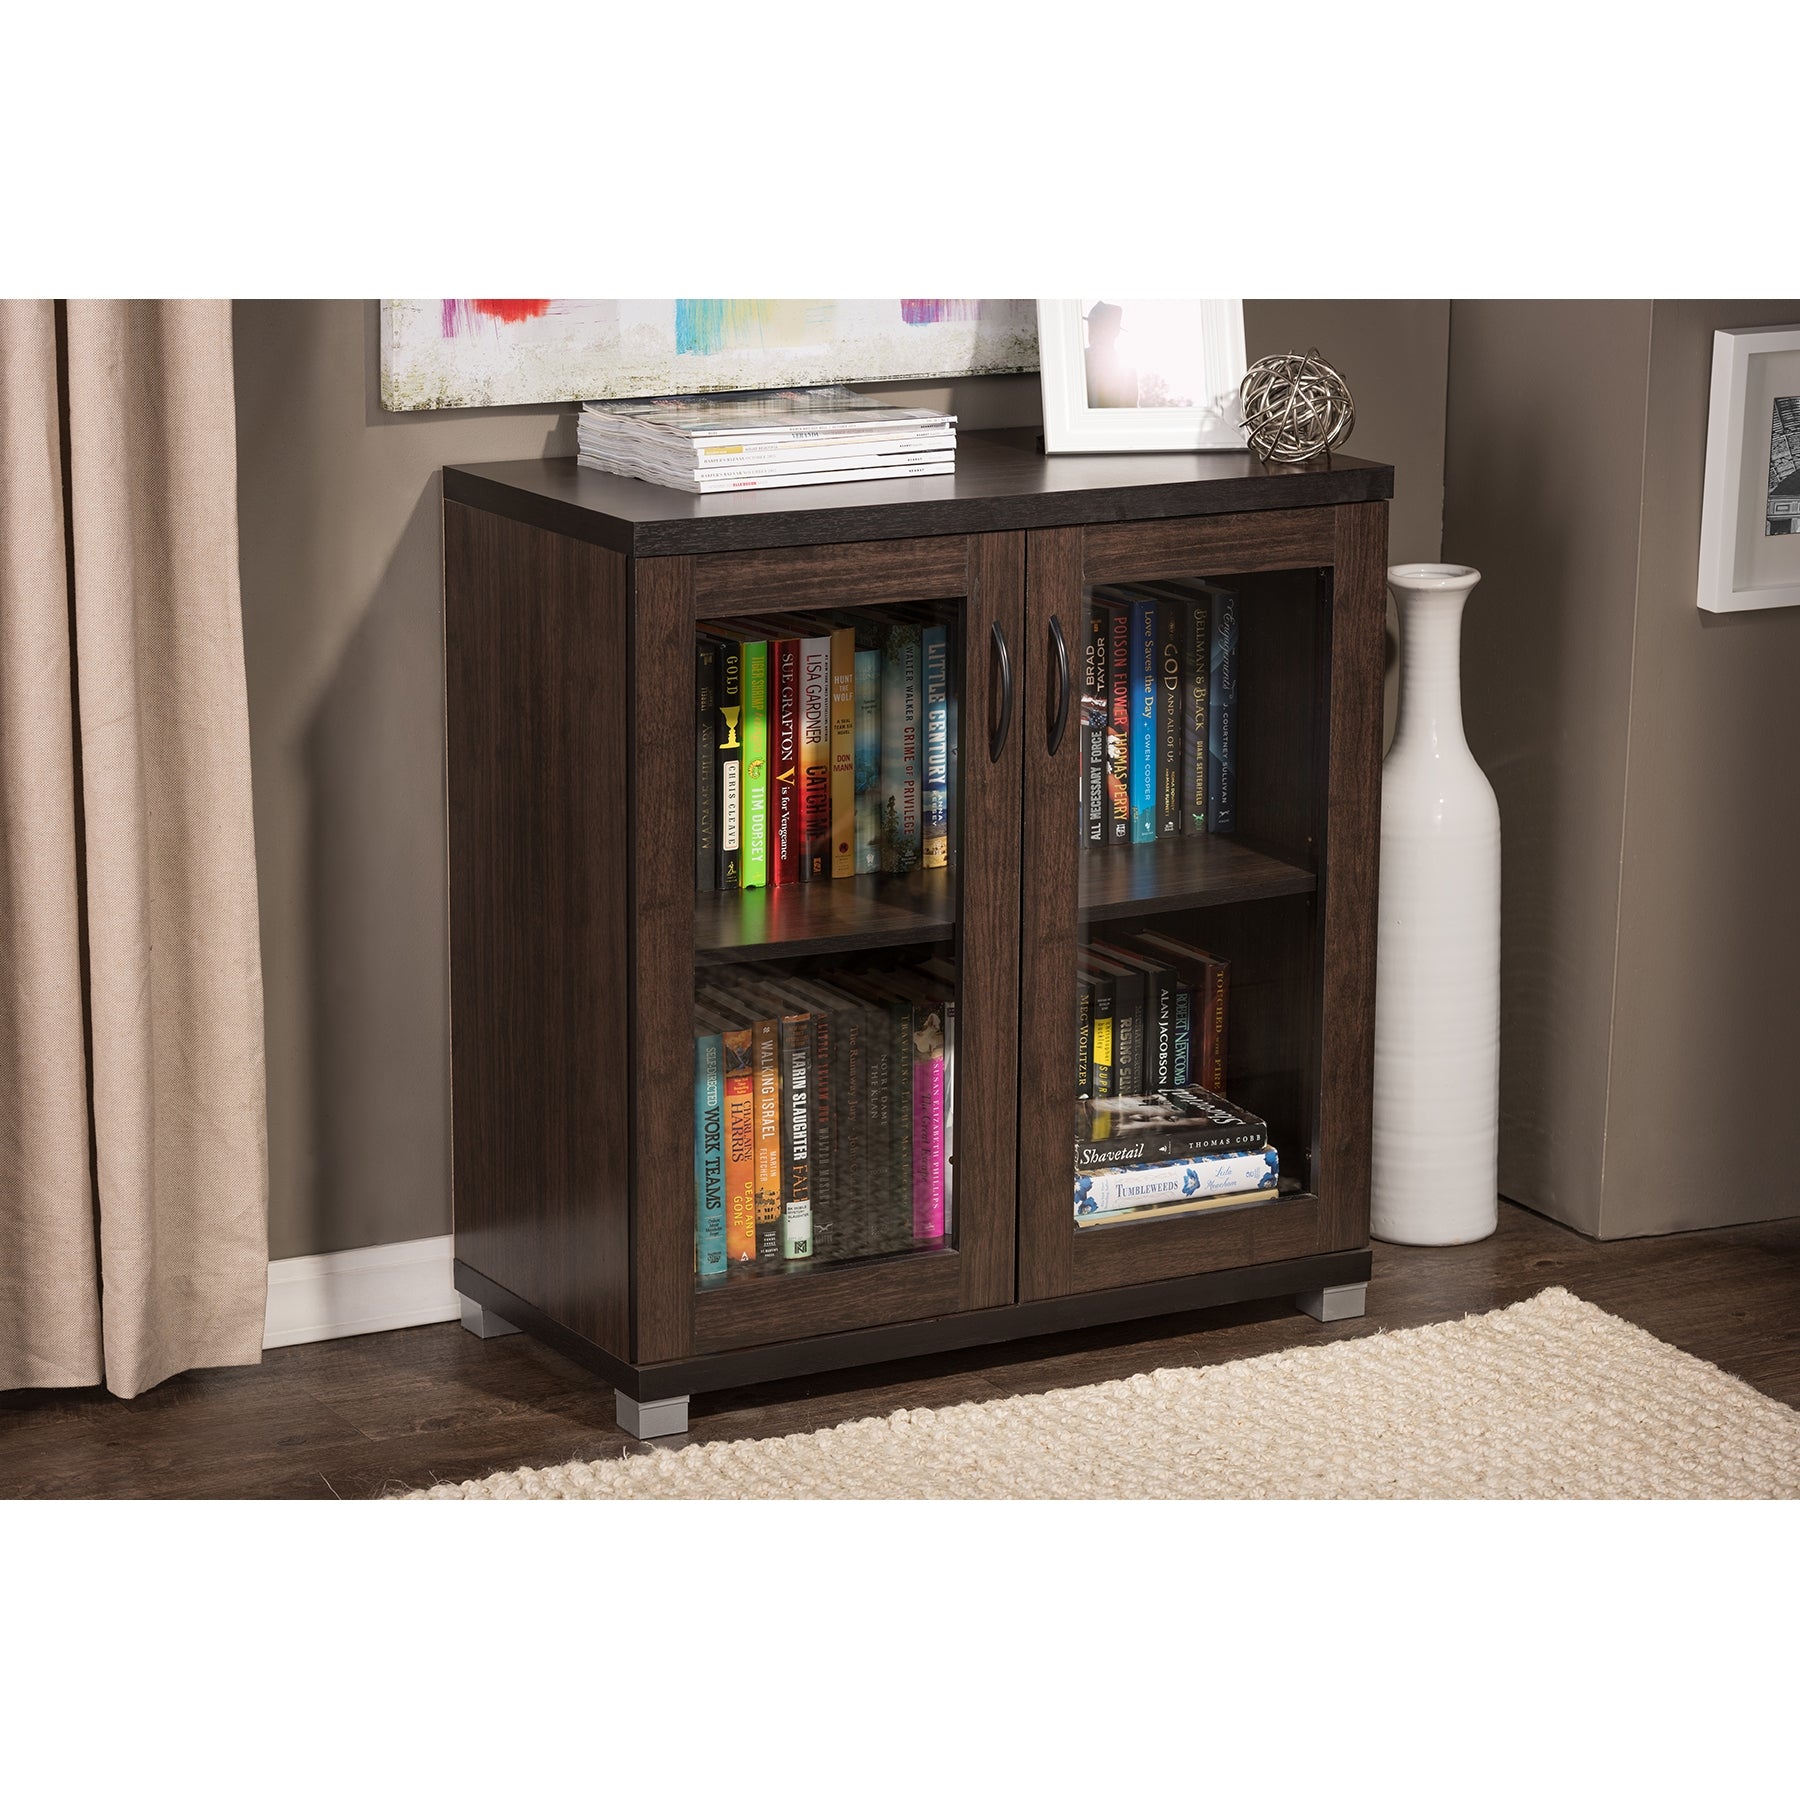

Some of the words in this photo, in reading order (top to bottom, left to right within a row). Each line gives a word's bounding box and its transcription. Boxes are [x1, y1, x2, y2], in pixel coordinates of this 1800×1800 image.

[1144, 610, 1155, 638] Love
[1193, 608, 1208, 674] BELLMAN
[1112, 616, 1129, 669] POISON
[1144, 640, 1154, 673] Saves
[726, 655, 739, 695] GOLD
[751, 656, 765, 679] TIGER
[781, 653, 794, 684] SUE
[805, 653, 823, 682] LISA
[833, 674, 853, 686] HUNT
[905, 646, 914, 682] WALTER
[928, 642, 946, 704] LITTLE
[1086, 645, 1096, 687] BRAD
[1097, 636, 1106, 693] TAYLOR
[1163, 643, 1179, 691] GOD
[1195, 676, 1204, 685] &
[751, 679, 765, 711] SHRIMP
[832, 691, 854, 703] WOLF
[839, 684, 849, 692] THE
[1112, 672, 1129, 726] FLOWER
[1144, 674, 1155, 694] the
[805, 684, 822, 745] GARDNER
[905, 684, 914, 722] WALKER
[1142, 696, 1154, 720] Day
[1167, 693, 1175, 715] AND
[1193, 687, 1207, 732] BLACK
[1223, 702, 1230, 710] J.
[781, 686, 794, 762] GRAFTON
[1167, 717, 1175, 735] ALL
[1222, 713, 1230, 759] COURTNEY
[836, 754, 851, 763] DON
[904, 726, 916, 762] CRIME
[928, 709, 947, 784] CENTURY
[1090, 730, 1103, 764] FORCE
[1113, 731, 1129, 781] THOMAS
[1144, 733, 1152, 762] GWEN
[1166, 736, 1174, 749] OF
[1166, 750, 1175, 764] US
[1196, 740, 1204, 761] DIANE
[728, 765, 738, 800] CHRIS
[775, 766, 796, 786] V
[832, 763, 854, 772] MANN
[905, 766, 914, 776] OF
[1144, 763, 1152, 802] COOPER
[1196, 762, 1204, 806] SETTERFIELD
[1221, 761, 1229, 804] SULLIVAN
[751, 787, 765, 811] TIM
[781, 787, 790, 796] is
[781, 797, 791, 811] for
[805, 765, 829, 815] CATCH
[904, 780, 916, 835] PRIVILEGE
[1089, 767, 1102, 822] NECESSARY
[1113, 784, 1128, 821] PERRY
[728, 803, 738, 846] CLEAVE
[751, 815, 766, 862] DORSEY
[778, 811, 790, 861] Vengeance
[806, 818, 829, 842] ME
[1090, 823, 1102, 841] ALL
[1079, 994, 1089, 1022] MEG
[1160, 987, 1170, 1020] ALAN
[1175, 992, 1188, 1032] ROBERT
[1215, 970, 1225, 1034] TOUCHED
[817, 1023, 829, 1059] LITTLE
[848, 1024, 860, 1047] The
[1119, 1017, 1133, 1066] RISING
[1158, 1021, 1170, 1085] JACOBSON
[761, 1039, 775, 1095] WALKING
[792, 1052, 806, 1090] KARIN
[847, 1048, 859, 1096] Runaway
[880, 1053, 889, 1093] NOTRE
[1078, 1024, 1090, 1087] WOLITZER
[1174, 1031, 1190, 1086] NEWCOMB
[705, 1046, 718, 1107] SELF-DIRECTED
[817, 1063, 829, 1100] YELLOW
[871, 1063, 879, 1087] THE
[932, 1062, 941, 1096] SUSAN
[1214, 1059, 1223, 1090] FIRE
[761, 1098, 776, 1140] ISRAEL
[847, 1099, 859, 1122] Jury
[871, 1089, 879, 1119] KLAN
[880, 1095, 889, 1129] DAME
[901, 1090, 911, 1130] LIGHT
[704, 1107, 721, 1154] WORK
[731, 1102, 744, 1163] HARRIS
[743, 1100, 753, 1162] CHARLAINE
[792, 1092, 808, 1161] SLAUGHTER
[932, 1099, 941, 1158] ELIZABETH
[1188, 1138, 1231, 1149] THOMAS
[1235, 1134, 1262, 1143] COBB
[769, 1150, 778, 1178] MARTIN
[818, 1127, 830, 1165] WALTER
[1080, 1143, 1145, 1165] Shavetail
[705, 1155, 722, 1211] TEAMS
[759, 1147, 769, 1183] FLETCHER
[744, 1181, 754, 1211] DEAD
[818, 1168, 830, 1208] MOSLEY
[932, 1161, 940, 1210] PHILLIPS
[1115, 1179, 1179, 1198] TUMBLEWEEDS
[733, 1195, 743, 1227] GONE
[744, 1214, 754, 1239] AND
